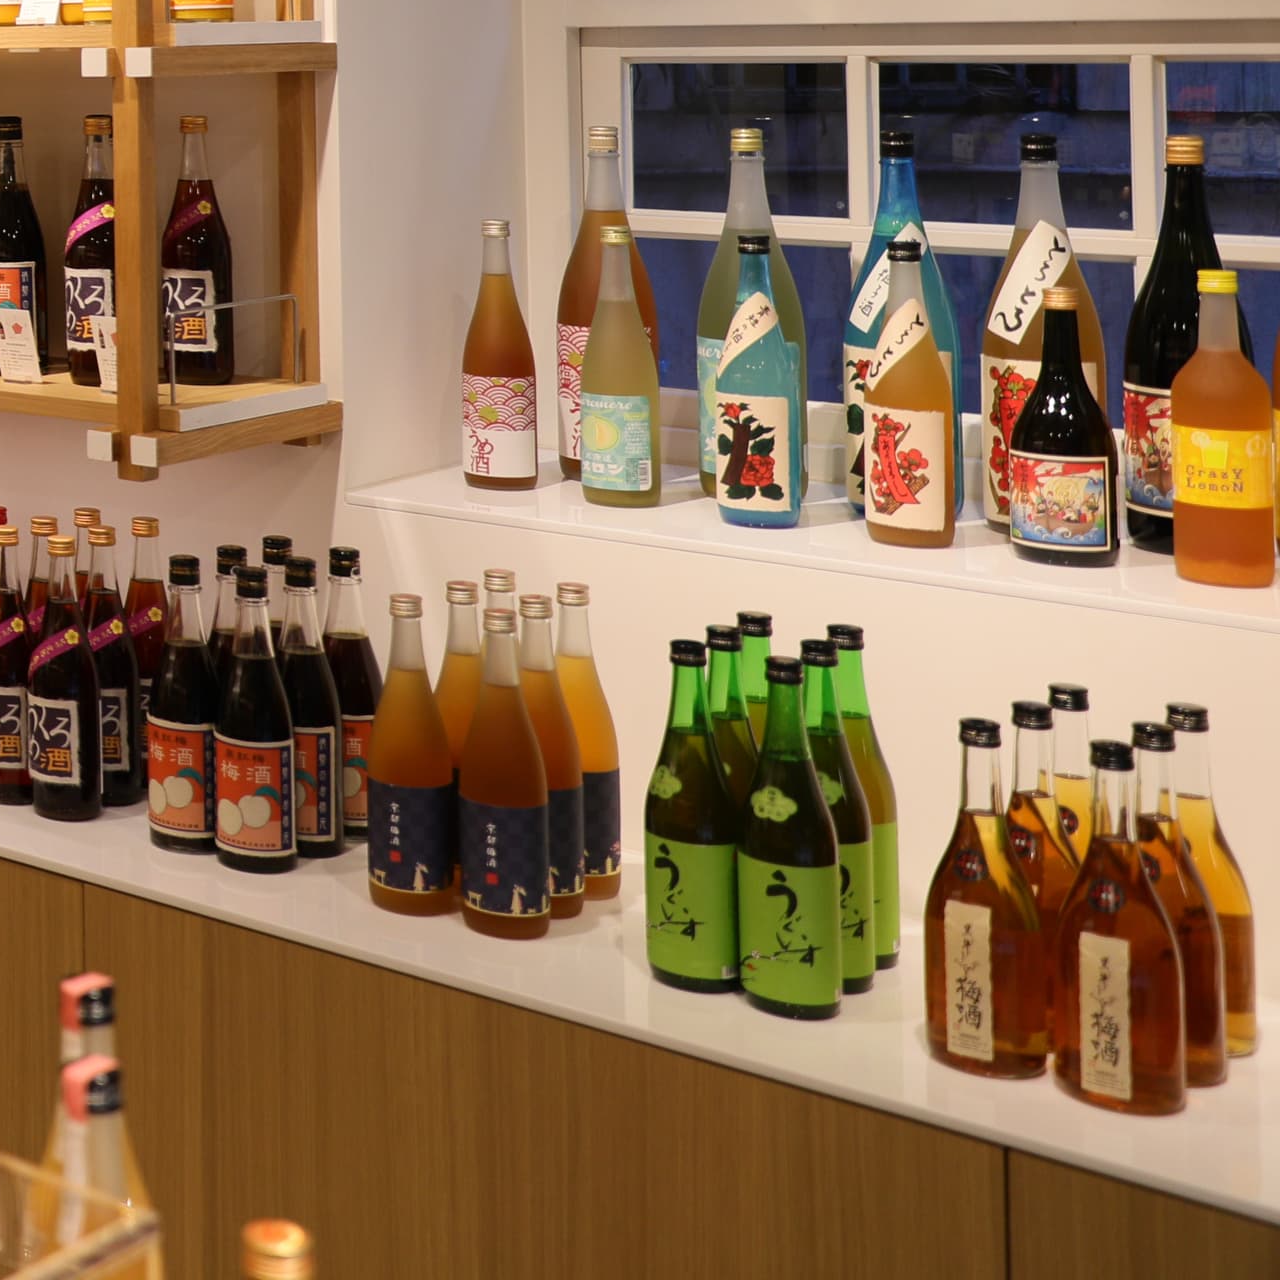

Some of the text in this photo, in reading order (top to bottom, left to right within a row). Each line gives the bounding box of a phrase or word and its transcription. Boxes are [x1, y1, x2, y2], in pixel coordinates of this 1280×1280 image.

[149, 741, 195, 767] 梅酒
[220, 759, 272, 785] 梅酒
[652, 842, 705, 942] うぐいす
[764, 869, 824, 968] うぐいす
